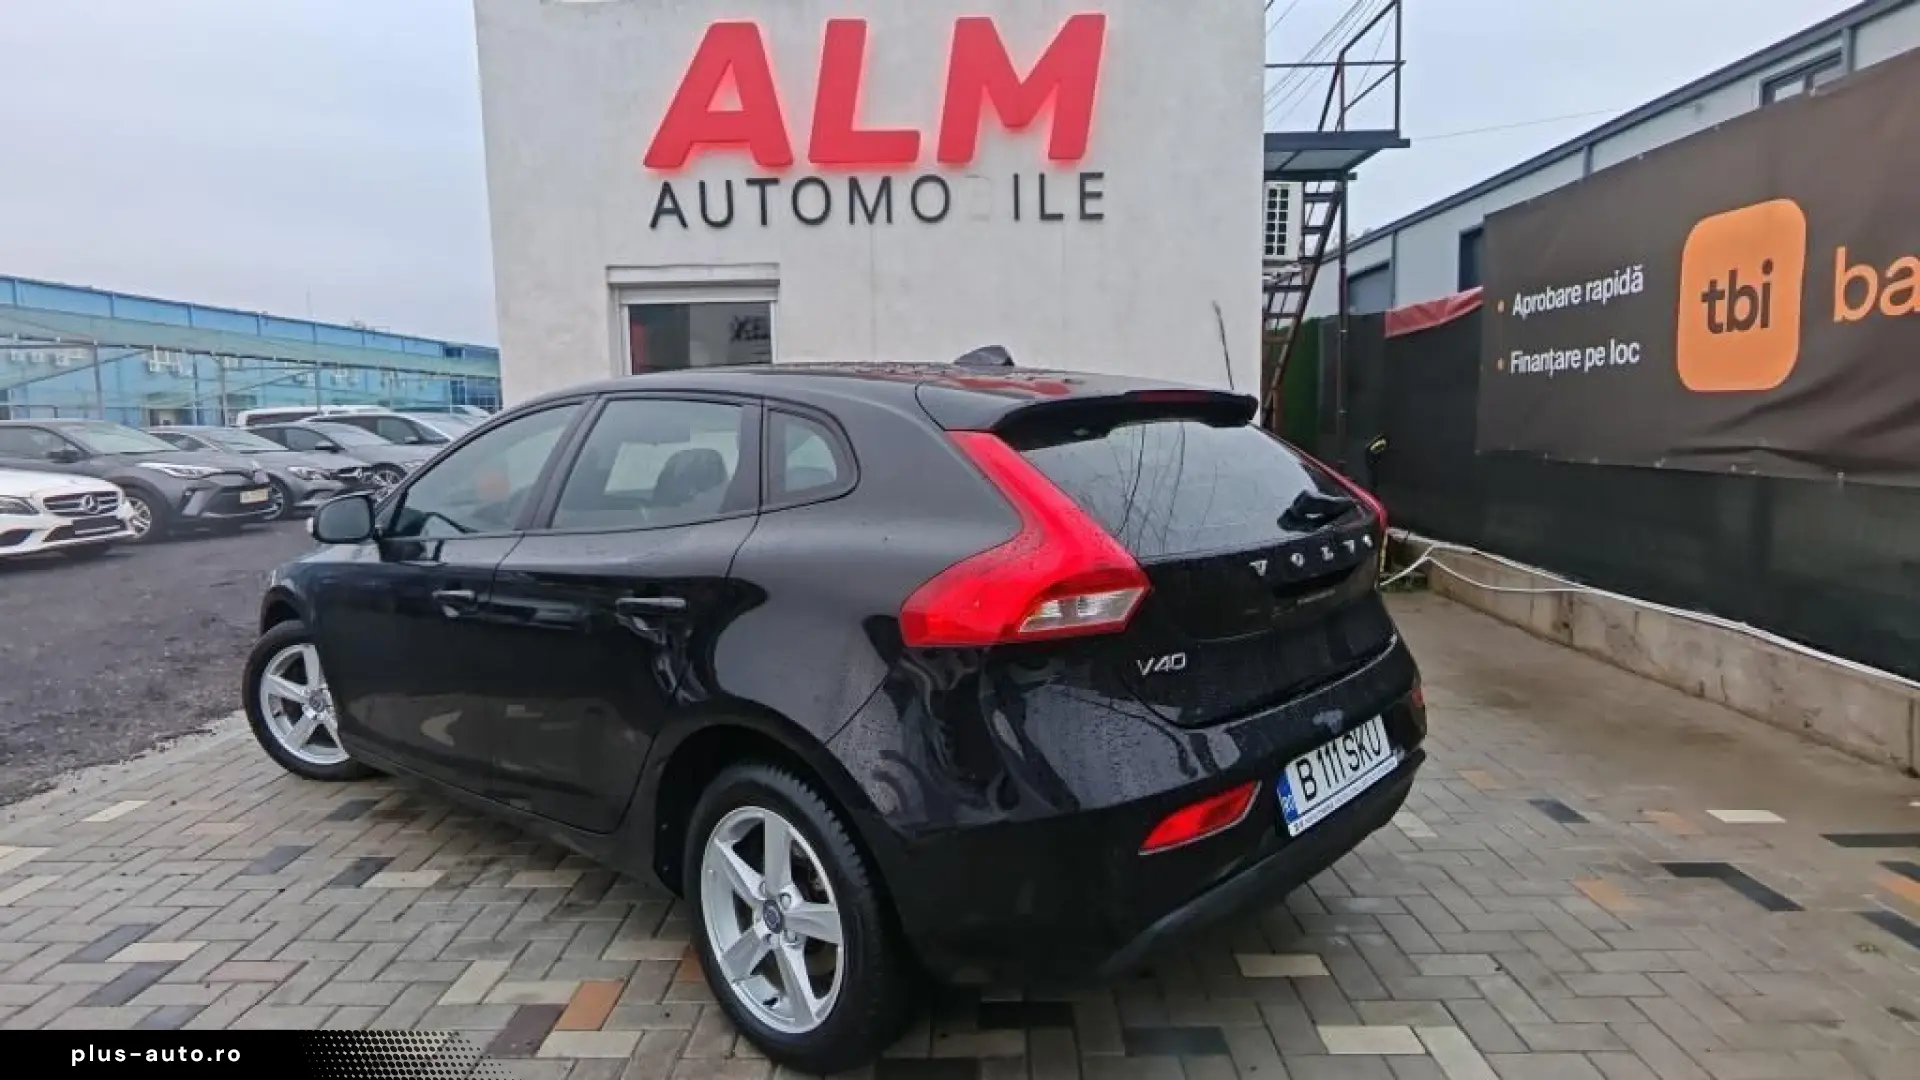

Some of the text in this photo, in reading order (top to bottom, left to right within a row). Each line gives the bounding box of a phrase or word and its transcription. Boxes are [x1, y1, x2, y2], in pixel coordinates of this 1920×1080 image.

[643, 14, 1106, 167] ALM
[650, 171, 1105, 229] AUTOMOILE
[1512, 263, 1644, 320] Aprobare rapidă
[1701, 258, 1774, 334] tbi
[1584, 346, 1606, 372] pe
[1610, 338, 1641, 365] loc
[1136, 652, 1186, 676] V40
[1296, 757, 1317, 802] B
[1342, 719, 1381, 771] SKU
